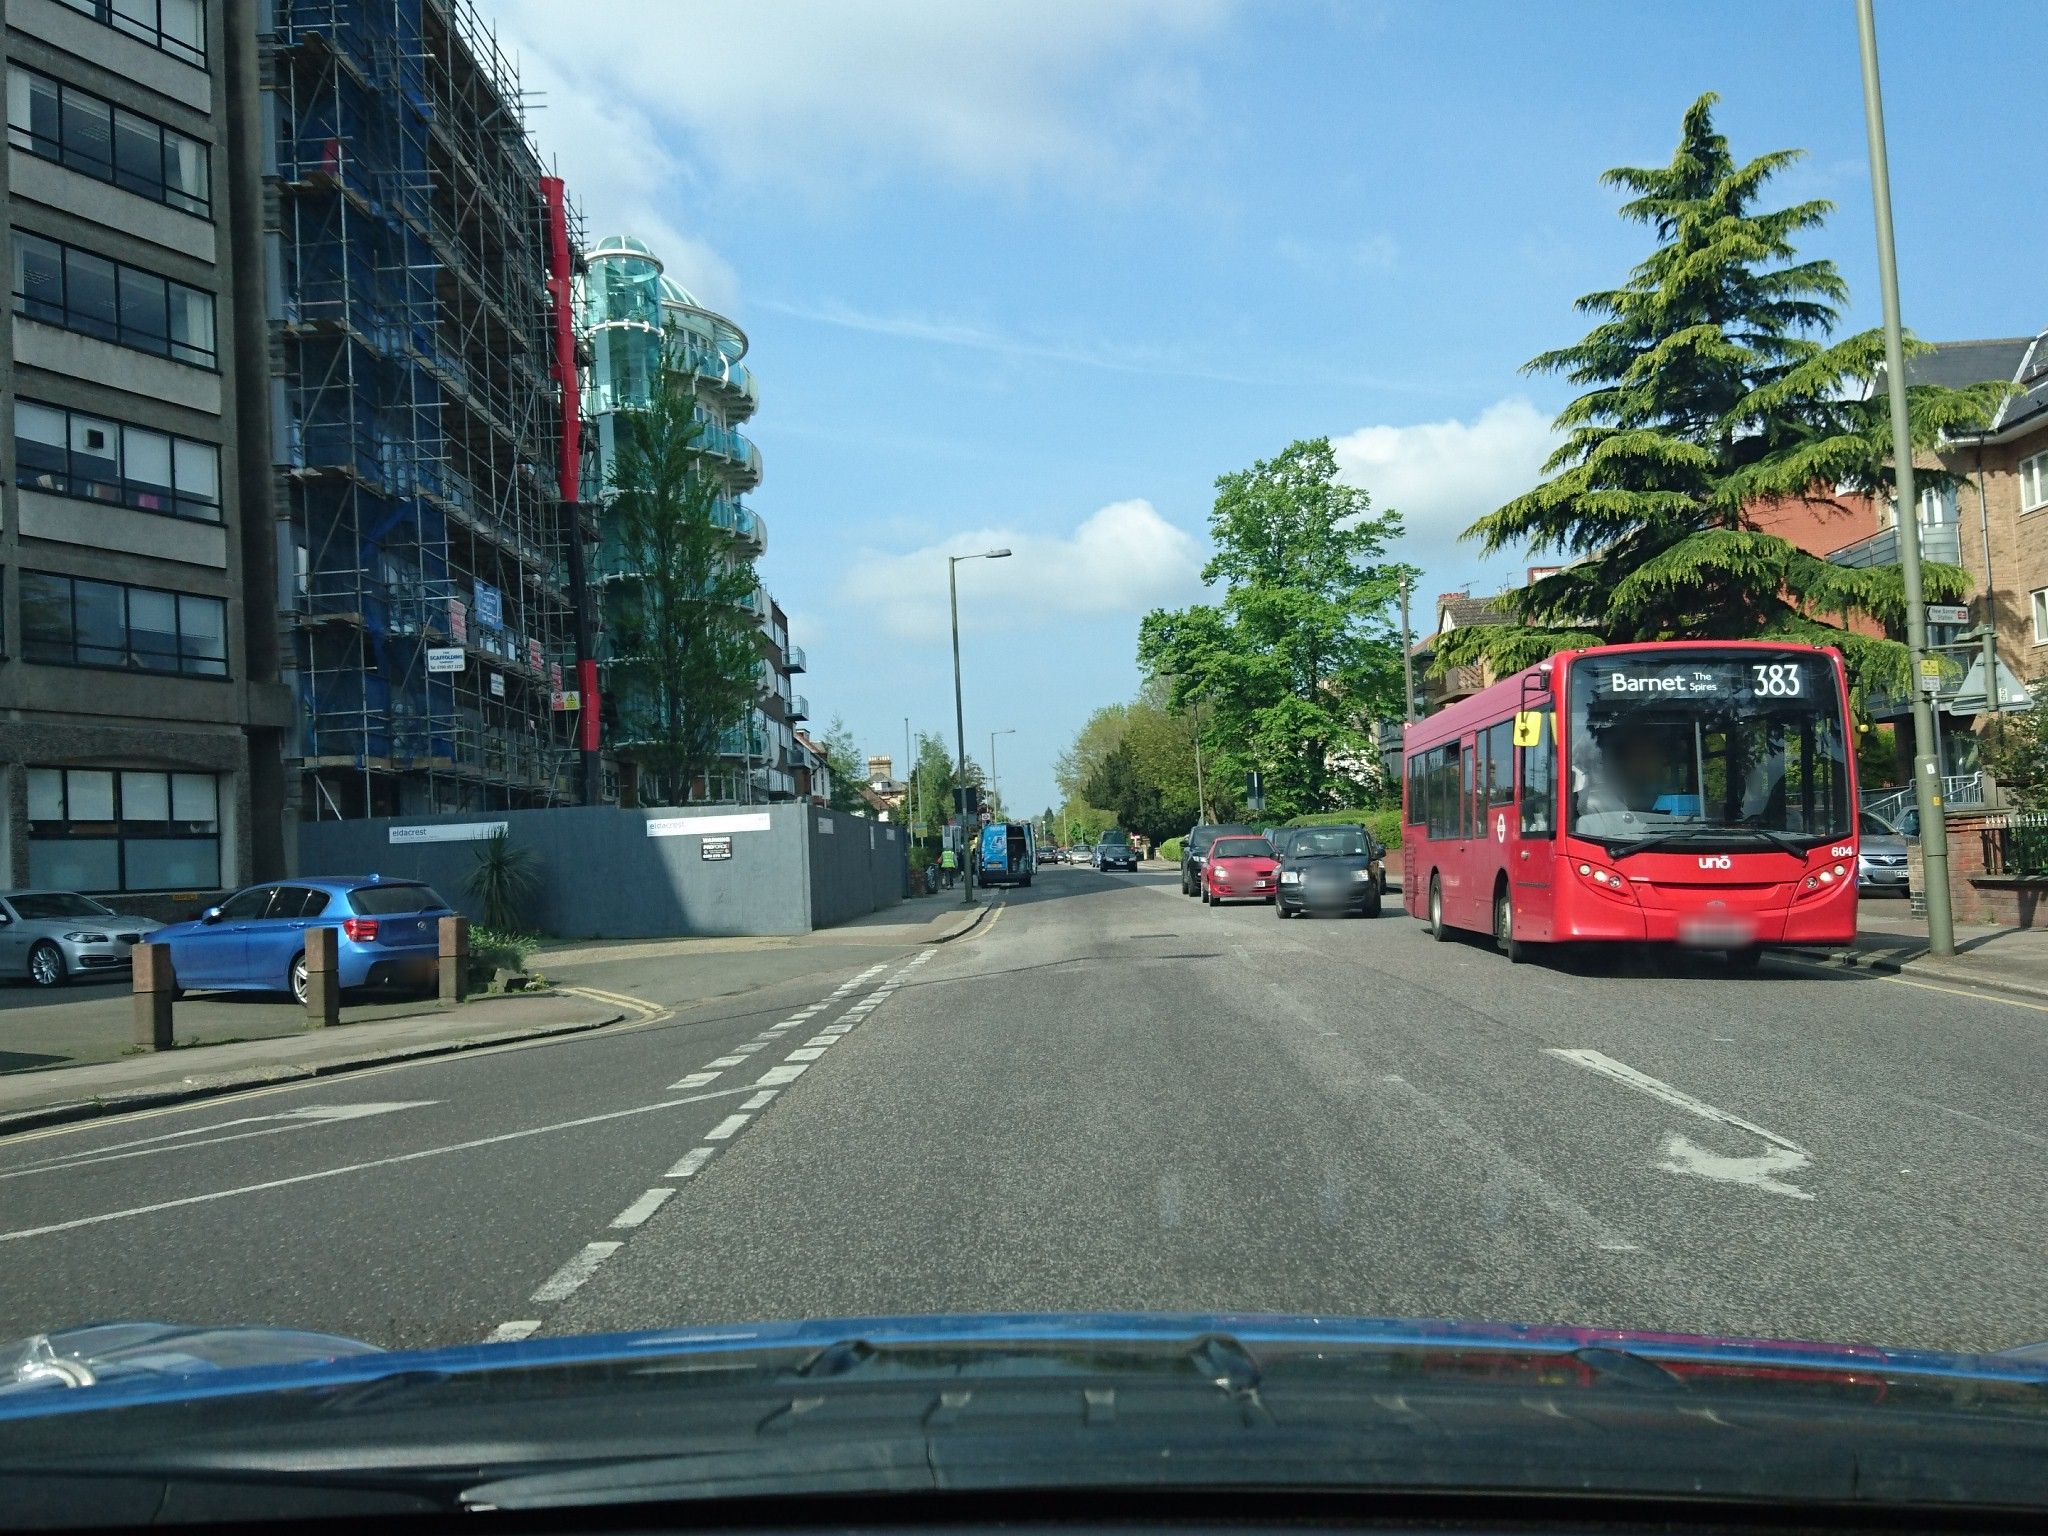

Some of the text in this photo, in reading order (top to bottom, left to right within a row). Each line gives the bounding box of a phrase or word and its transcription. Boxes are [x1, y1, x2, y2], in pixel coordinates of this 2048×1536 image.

[1693, 672, 1712, 681] The
[1752, 664, 1800, 697] 383
[1612, 672, 1686, 692] Barnet
[1689, 682, 1717, 692] Spires
[392, 828, 427, 837] eldacrest
[1831, 846, 1853, 857] 604
